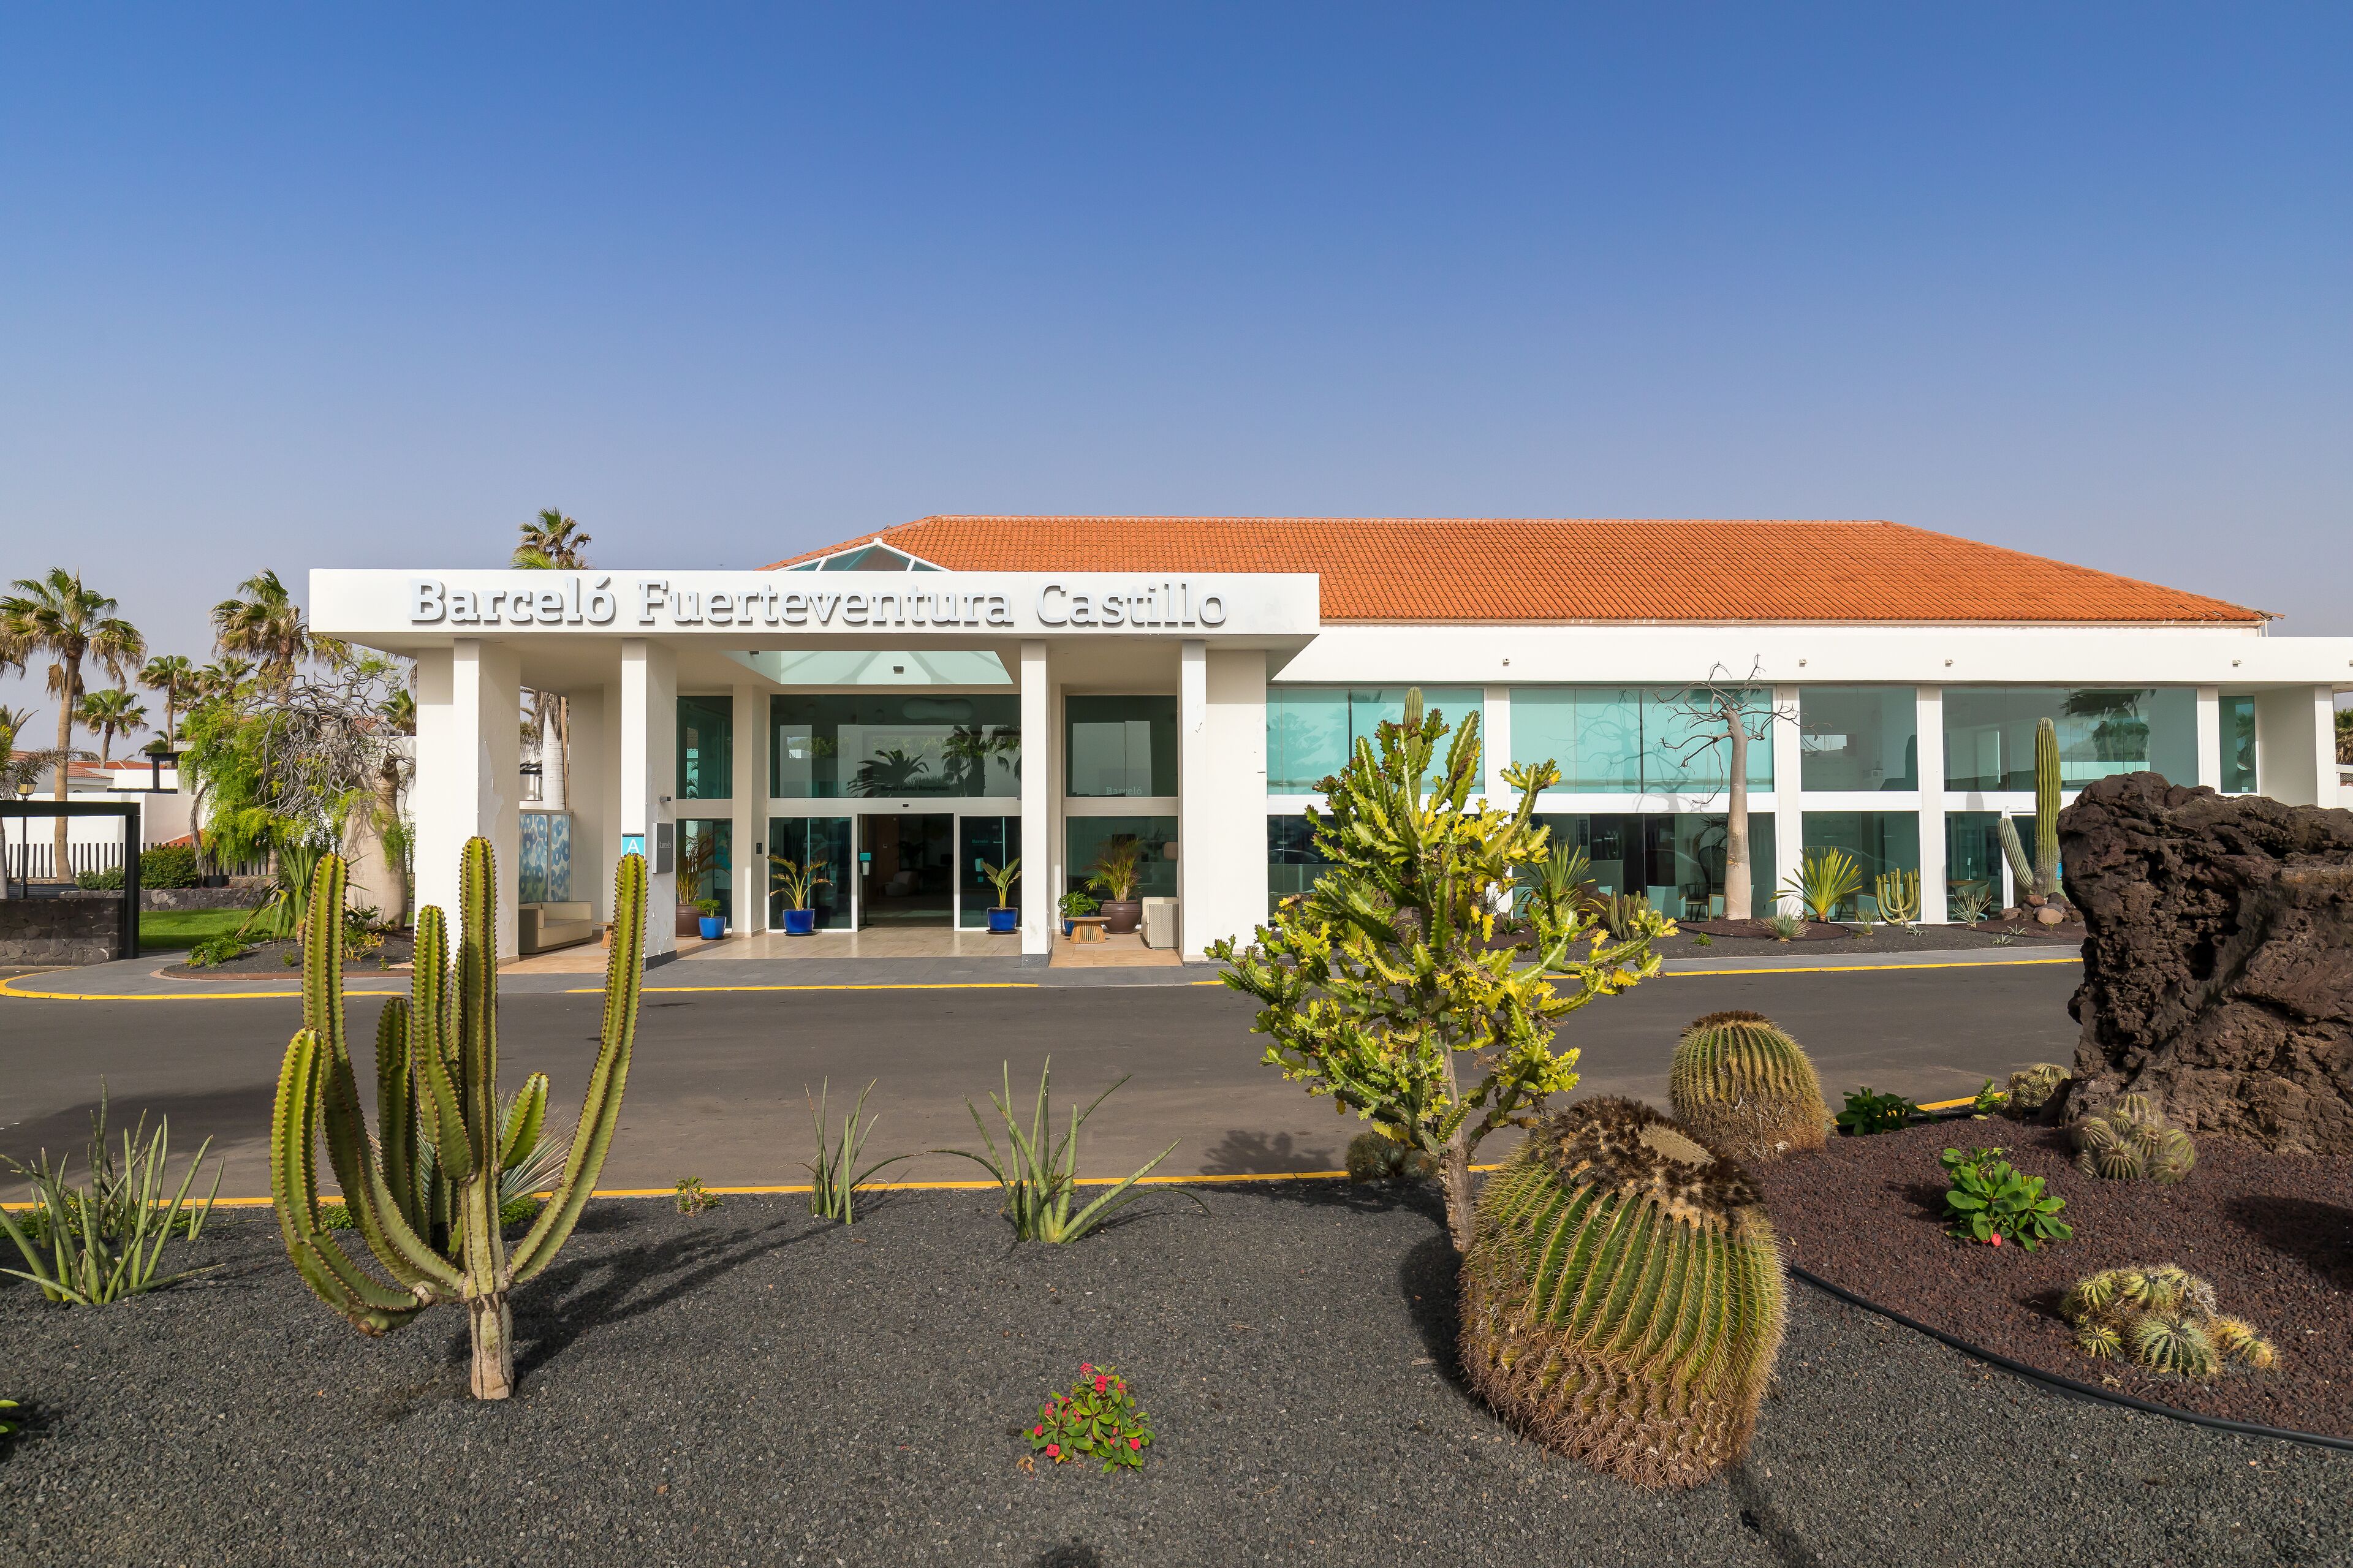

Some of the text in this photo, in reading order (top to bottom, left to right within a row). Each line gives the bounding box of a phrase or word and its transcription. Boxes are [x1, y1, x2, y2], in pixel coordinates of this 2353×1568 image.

[409, 575, 1228, 627] Barceló Fuerteventura Castillo
[626, 838, 640, 854] A
